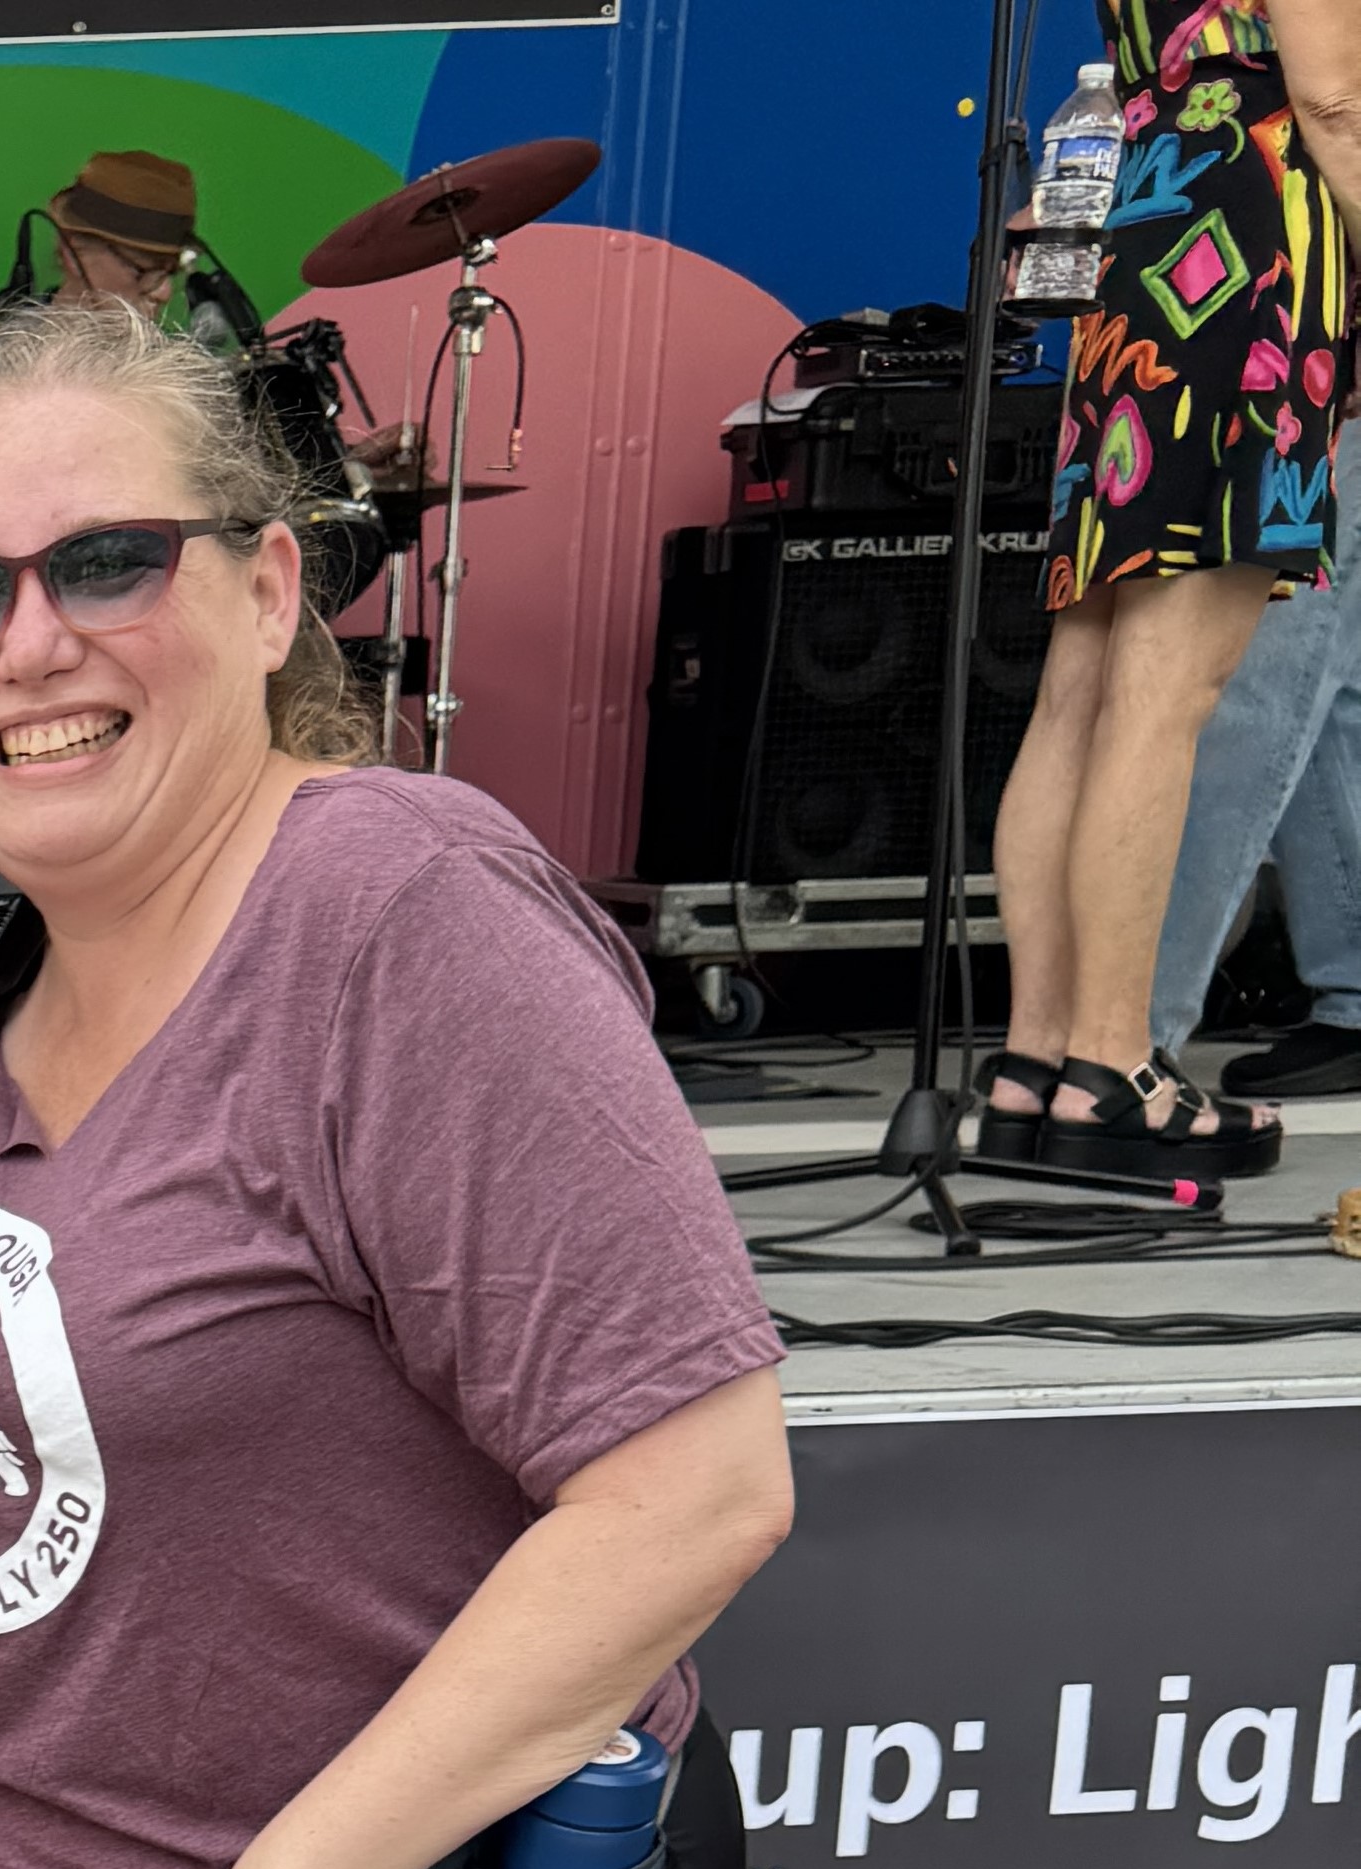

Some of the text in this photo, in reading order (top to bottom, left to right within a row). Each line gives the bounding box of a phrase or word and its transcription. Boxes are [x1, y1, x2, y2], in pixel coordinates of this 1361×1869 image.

[782, 538, 824, 562] GK
[978, 532, 1050, 552] KRU
[35, 1491, 91, 1579] 250
